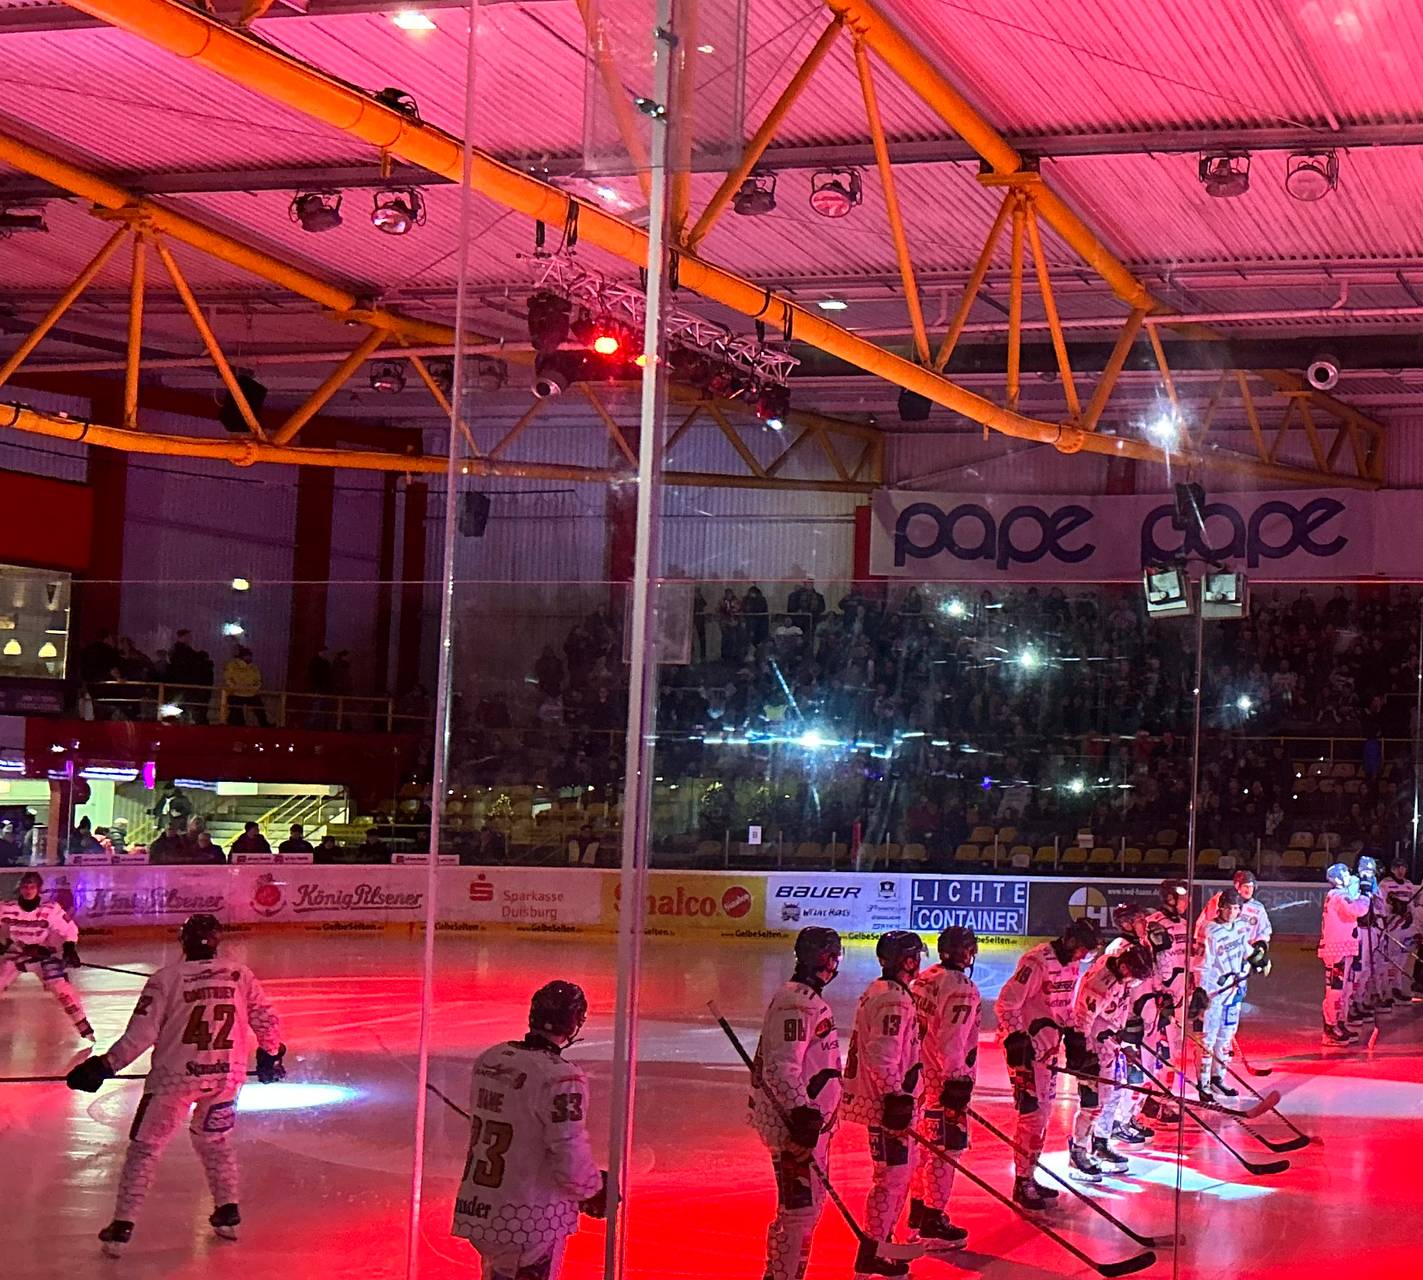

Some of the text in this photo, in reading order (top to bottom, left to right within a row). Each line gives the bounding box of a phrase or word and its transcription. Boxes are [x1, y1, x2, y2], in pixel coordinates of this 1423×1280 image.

[503, 891, 564, 903] Sparkasse
[614, 883, 717, 917] nalco
[913, 880, 1025, 904] LICHTE
[502, 905, 558, 920] Duisburg
[917, 909, 1019, 931] CONTAINER
[883, 1014, 902, 1037] 13
[952, 1004, 973, 1025] 77
[181, 1003, 236, 1051] 42
